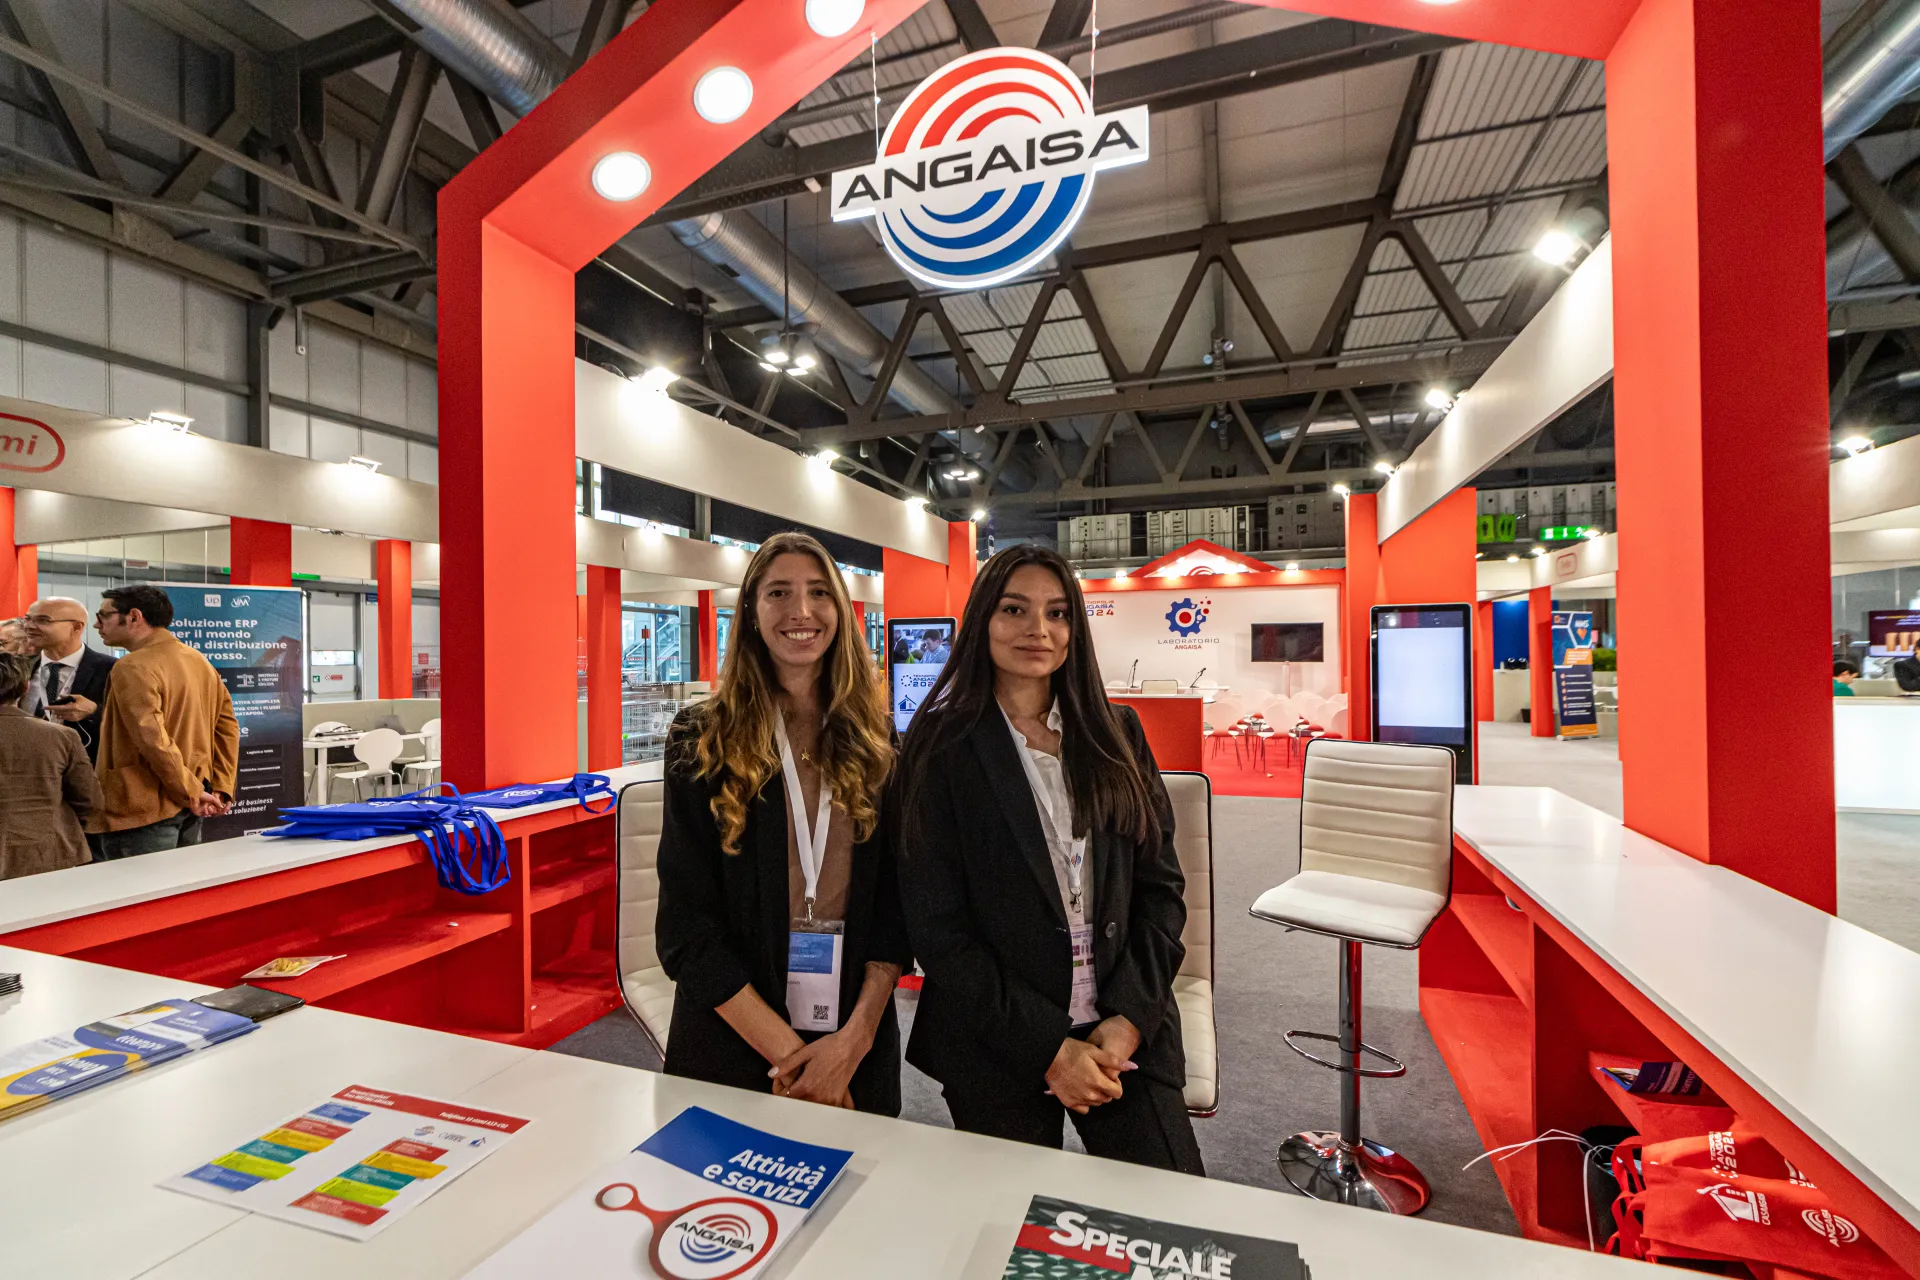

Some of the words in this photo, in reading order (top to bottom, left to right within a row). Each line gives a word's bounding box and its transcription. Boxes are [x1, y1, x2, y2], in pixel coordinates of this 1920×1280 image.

[838, 120, 1140, 208] ANGAISA
[170, 618, 232, 628] Soluzione
[235, 619, 259, 629] ERP
[194, 629, 202, 639] il
[206, 630, 251, 639] mondo
[204, 640, 288, 650] distribuzione
[702, 1163, 723, 1179] e
[721, 1171, 816, 1205] servizi
[728, 1149, 827, 1187] Attività
[674, 1221, 755, 1254] ANGAISA
[1048, 1211, 1233, 1280] SPECIALE
